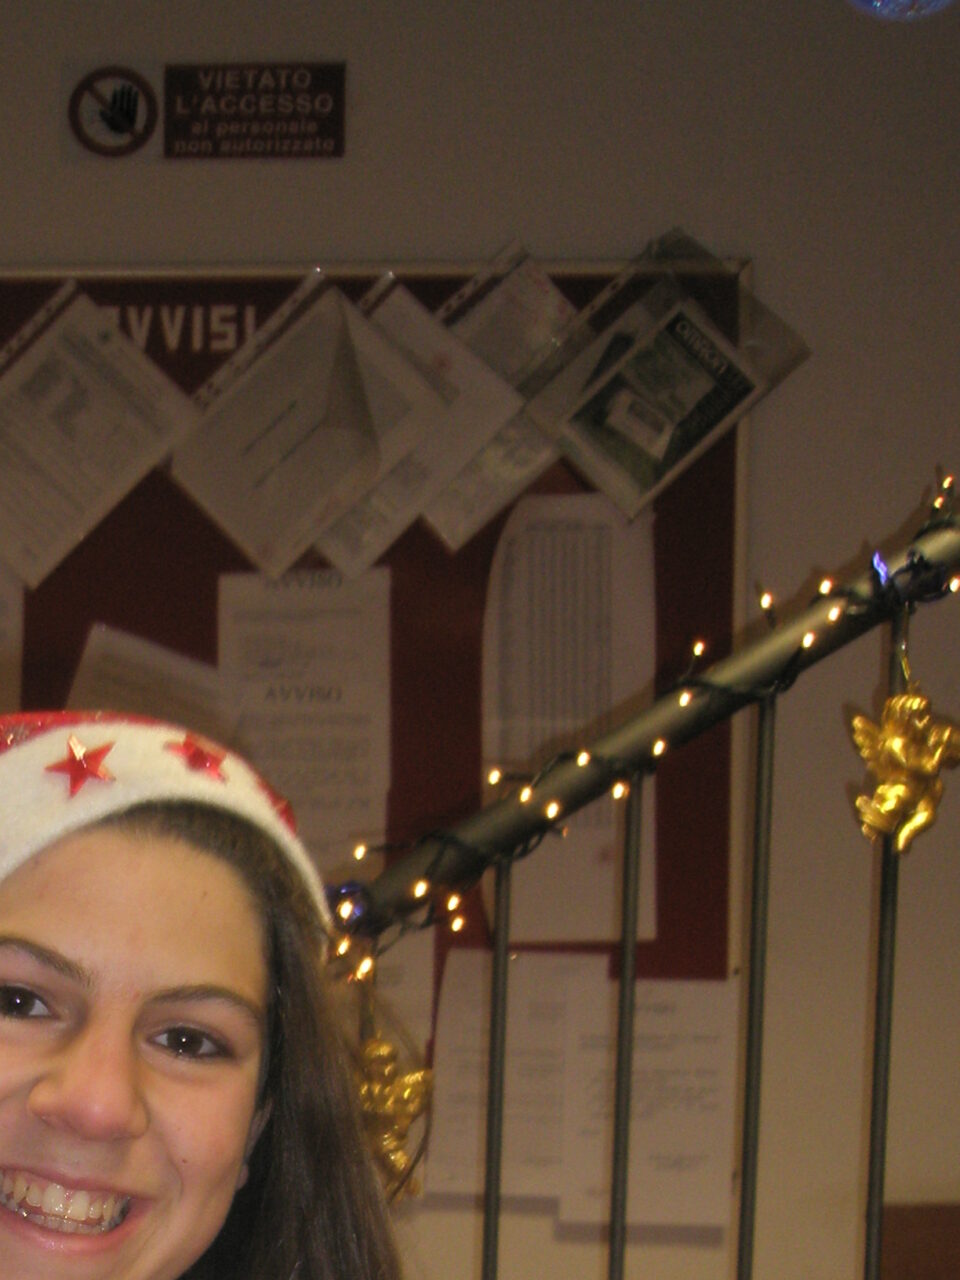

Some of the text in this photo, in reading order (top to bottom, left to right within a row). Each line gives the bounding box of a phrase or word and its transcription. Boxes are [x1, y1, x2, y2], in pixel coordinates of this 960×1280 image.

[198, 68, 312, 90] VIETATO
[175, 92, 334, 115] L'ACCESSO
[191, 119, 319, 138] al personale
[174, 138, 336, 154] non autorizzato
[92, 304, 256, 351] VVISI
